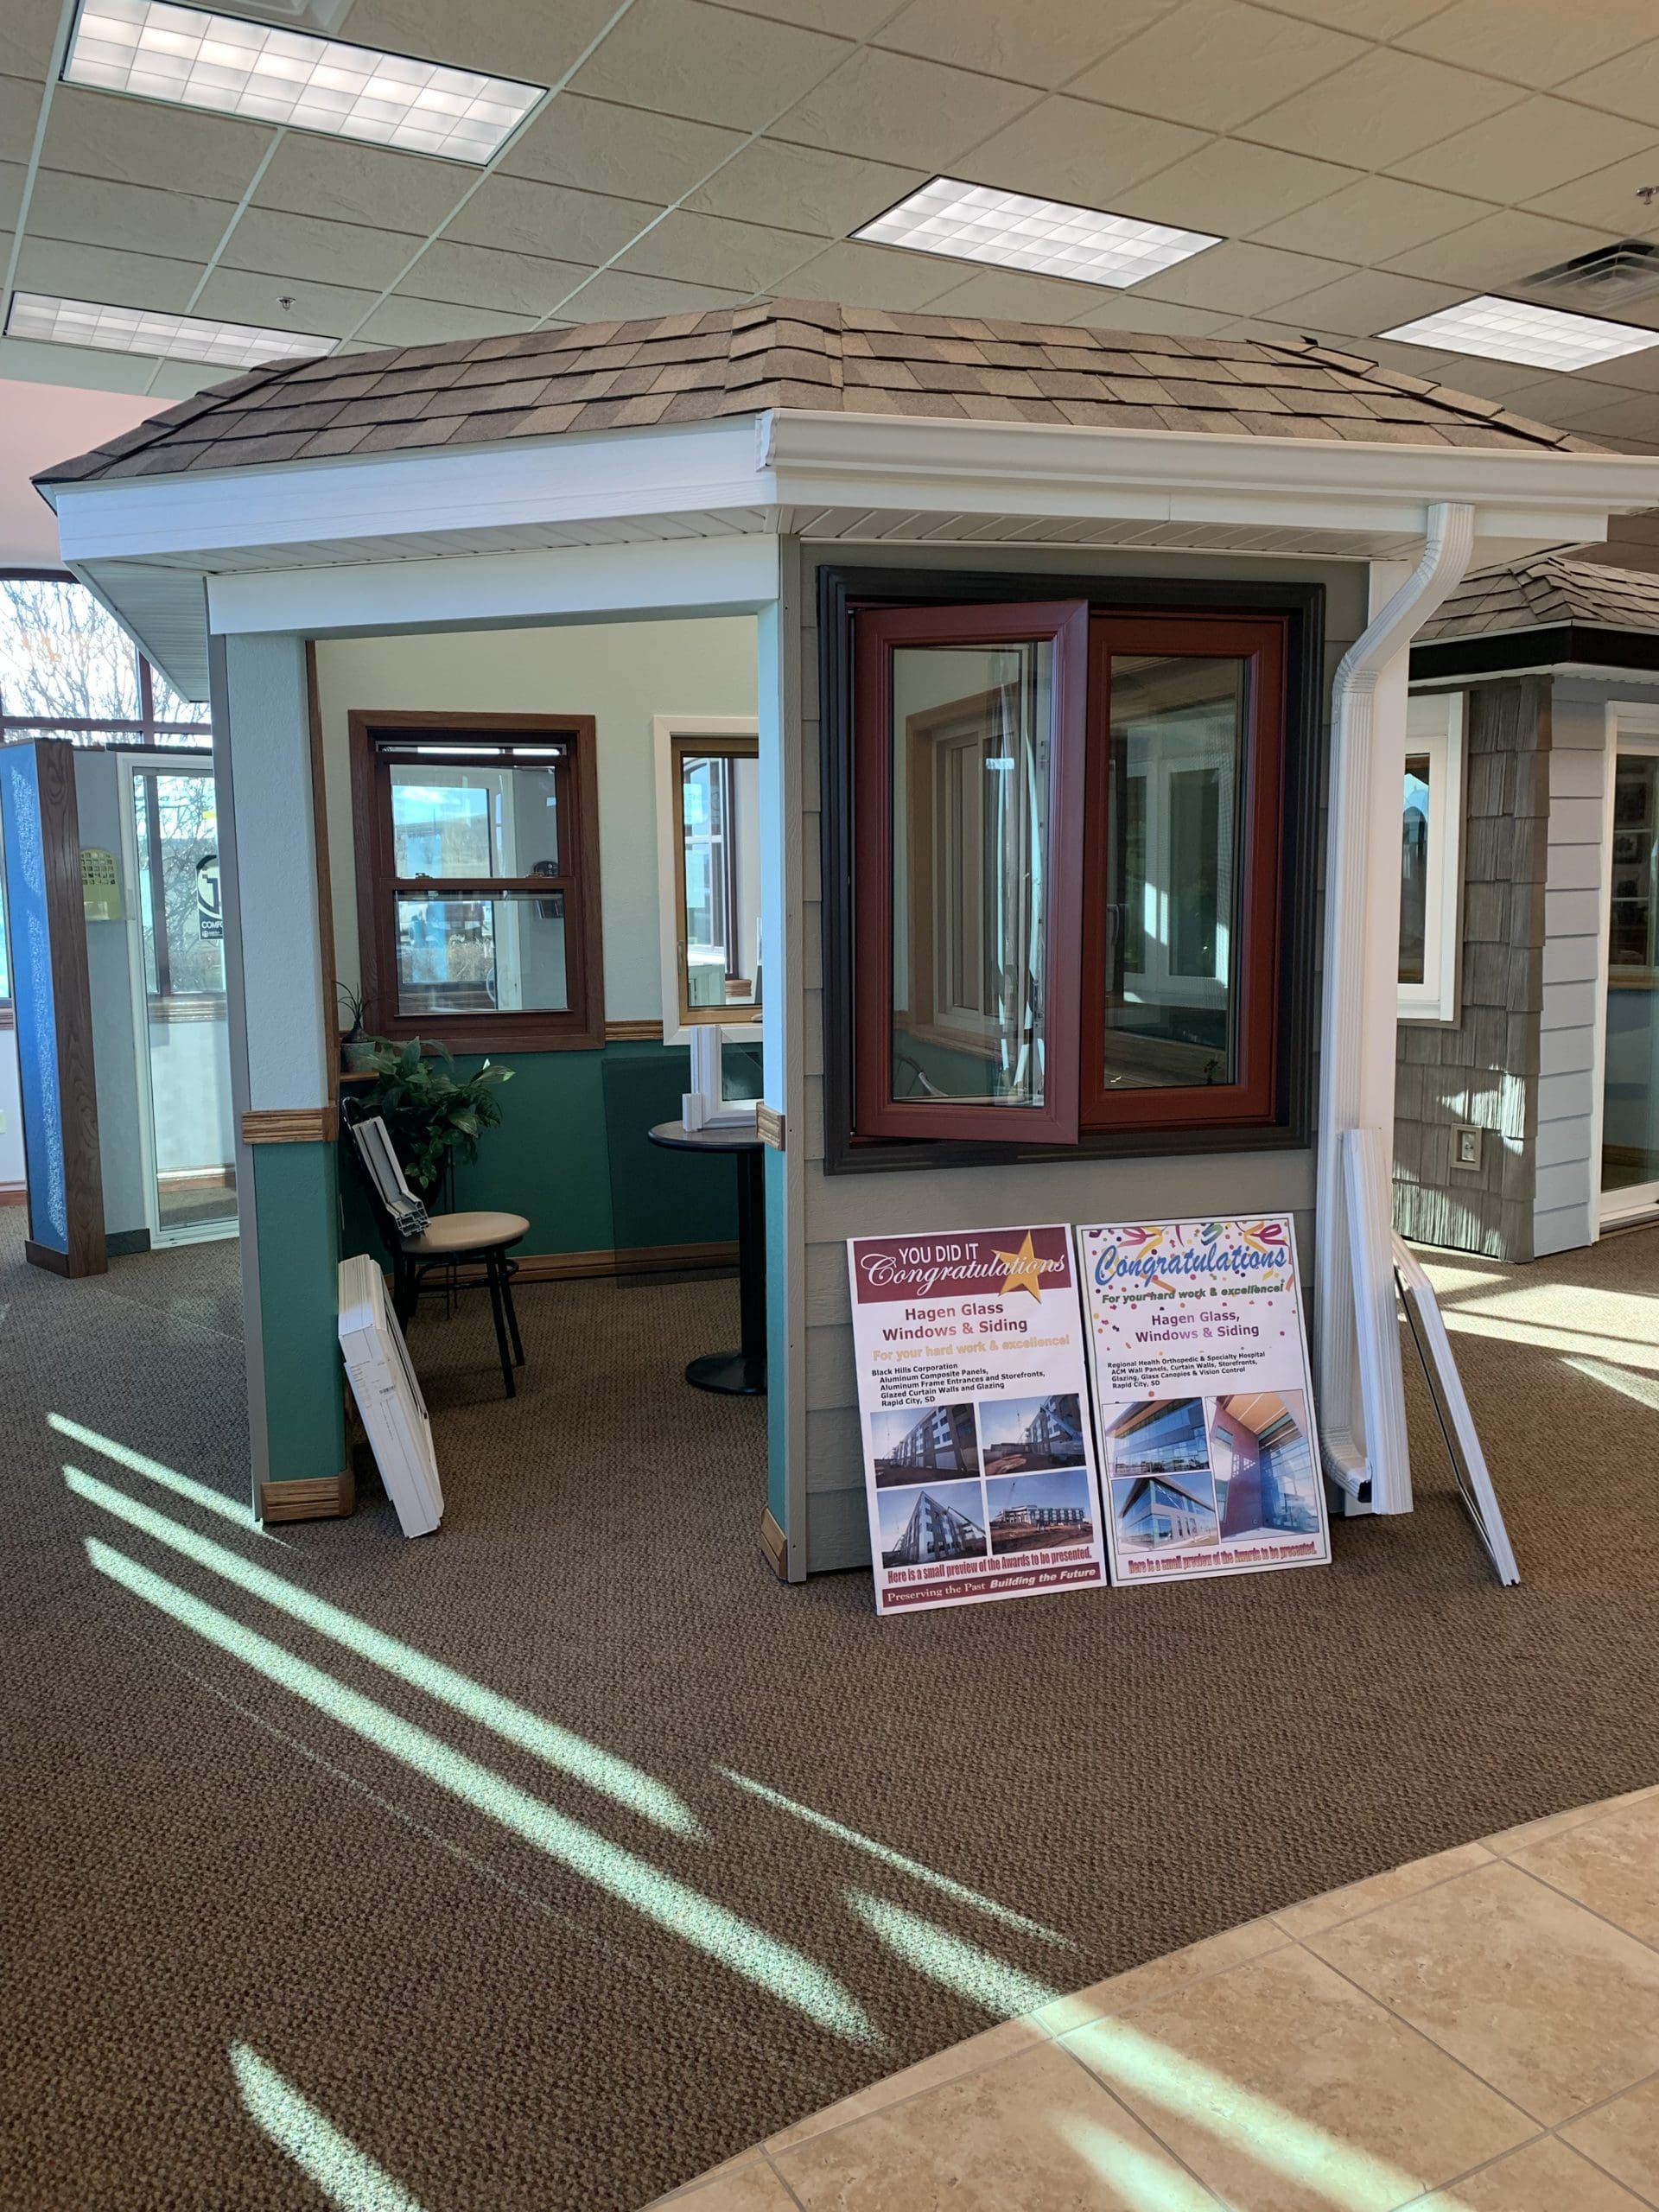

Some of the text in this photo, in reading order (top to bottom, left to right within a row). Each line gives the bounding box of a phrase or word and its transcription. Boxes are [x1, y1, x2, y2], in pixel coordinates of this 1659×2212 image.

[899, 1243, 978, 1265] YOU DID IT
[861, 1253, 1065, 1295] Congratulations
[1095, 1243, 1287, 1287] Congratulations
[1103, 1283, 1284, 1305] For your hard work & excellence!
[905, 1302, 1003, 1321] Hagen Glass
[1152, 1311, 1240, 1326] Hagen Glass,
[883, 1319, 1027, 1341] Windows & Siding
[1135, 1325, 1259, 1343] Windows & Siding
[873, 1334, 1070, 1362] For your hard work & excellence!
[1162, 1357, 1198, 1365] Orthopedic
[1207, 1354, 1237, 1363] Specialty
[1239, 1351, 1265, 1360] Hospital
[872, 1368, 893, 1376] Black
[913, 1363, 957, 1374] Corporation
[920, 1370, 959, 1381] Composite
[962, 1368, 988, 1376] Panels,
[1160, 1370, 1190, 1379] Canopies
[880, 1382, 919, 1391] Aluminum
[947, 1376, 983, 1385] Entrances
[1001, 1370, 1046, 1380] Storefronts,
[880, 1390, 906, 1399] Glazed
[977, 1382, 1004, 1390] Glazing
[881, 1399, 903, 1408] Rapid
[887, 1547, 1092, 1583] Here is a small preview of the Awards to be presented.
[887, 1567, 1096, 1602] Preserving the Past Building the Future
